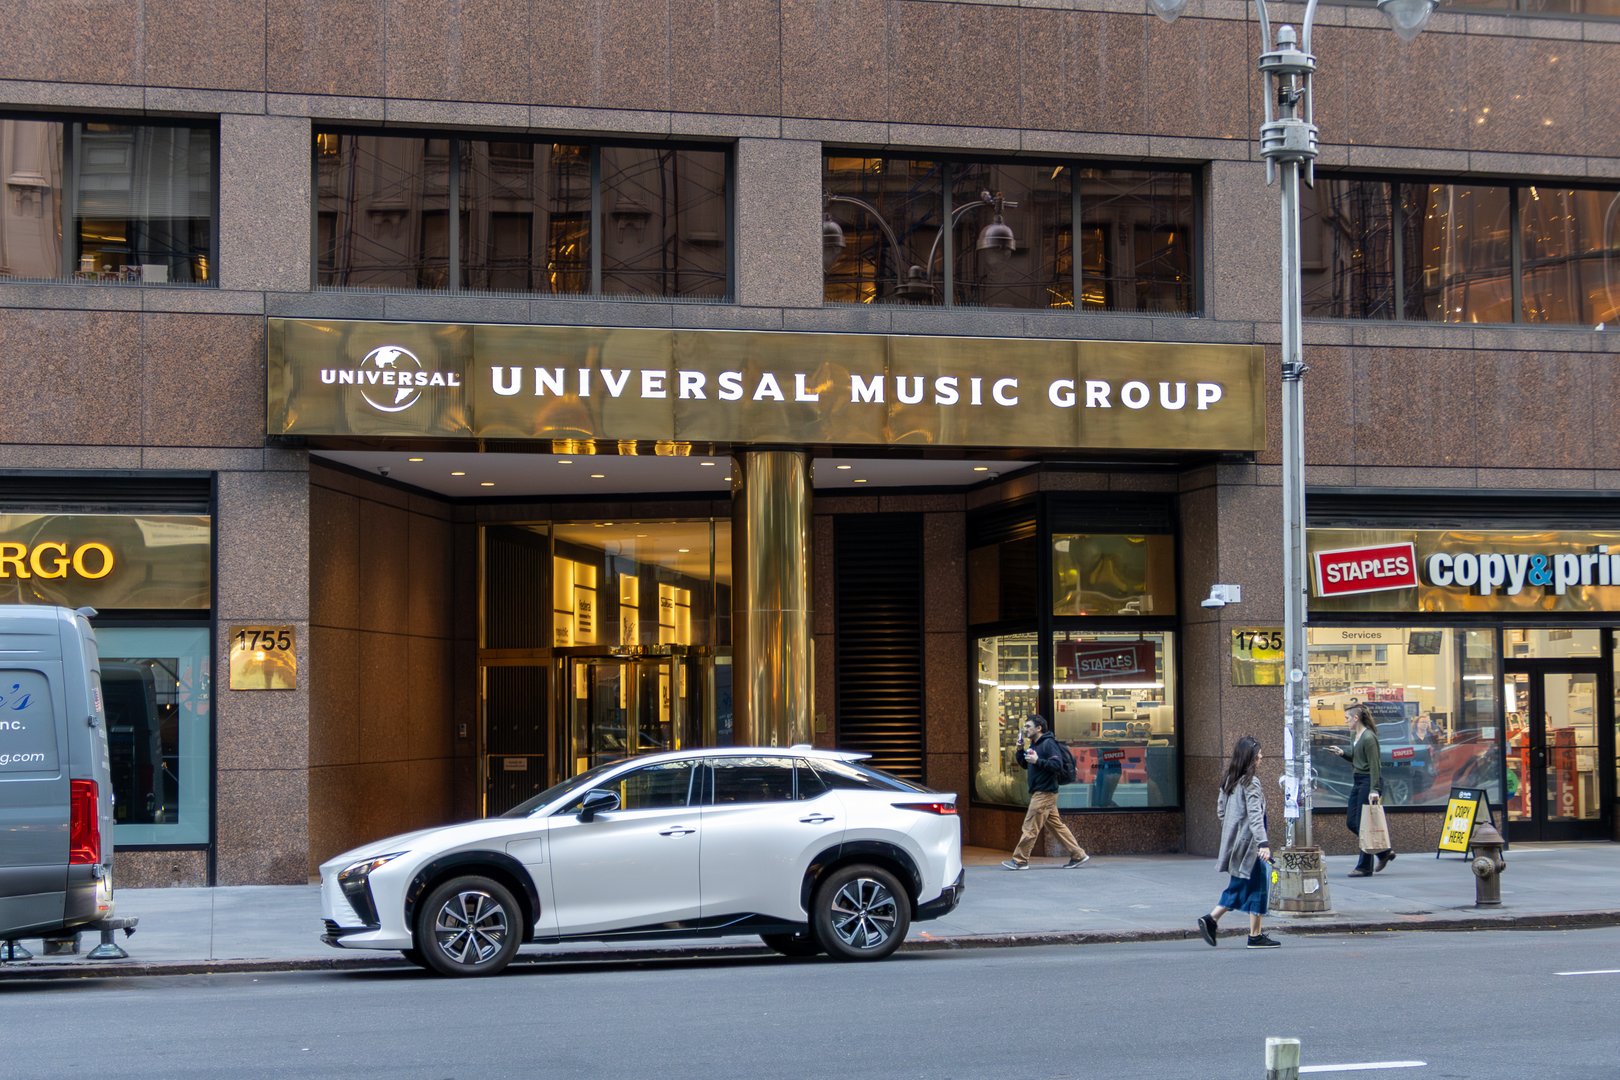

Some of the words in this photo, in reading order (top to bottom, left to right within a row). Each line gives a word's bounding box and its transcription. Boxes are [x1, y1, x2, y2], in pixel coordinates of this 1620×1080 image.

[321, 369, 461, 388] UNIVERSAL
[491, 366, 821, 403] UNIVERSAL
[850, 375, 1019, 407] MUSIC
[1048, 379, 1223, 411] GROUP
[1326, 556, 1410, 583] STAPLES
[235, 630, 291, 651] 1755
[1236, 631, 1282, 650] 1755
[1341, 631, 1382, 639] Services
[1081, 655, 1133, 671] STAPLES
[1379, 687, 1397, 695] HOT
[1562, 782, 1575, 817] HOT
[1455, 805, 1471, 818] COPY
[1449, 830, 1465, 844] HERE
